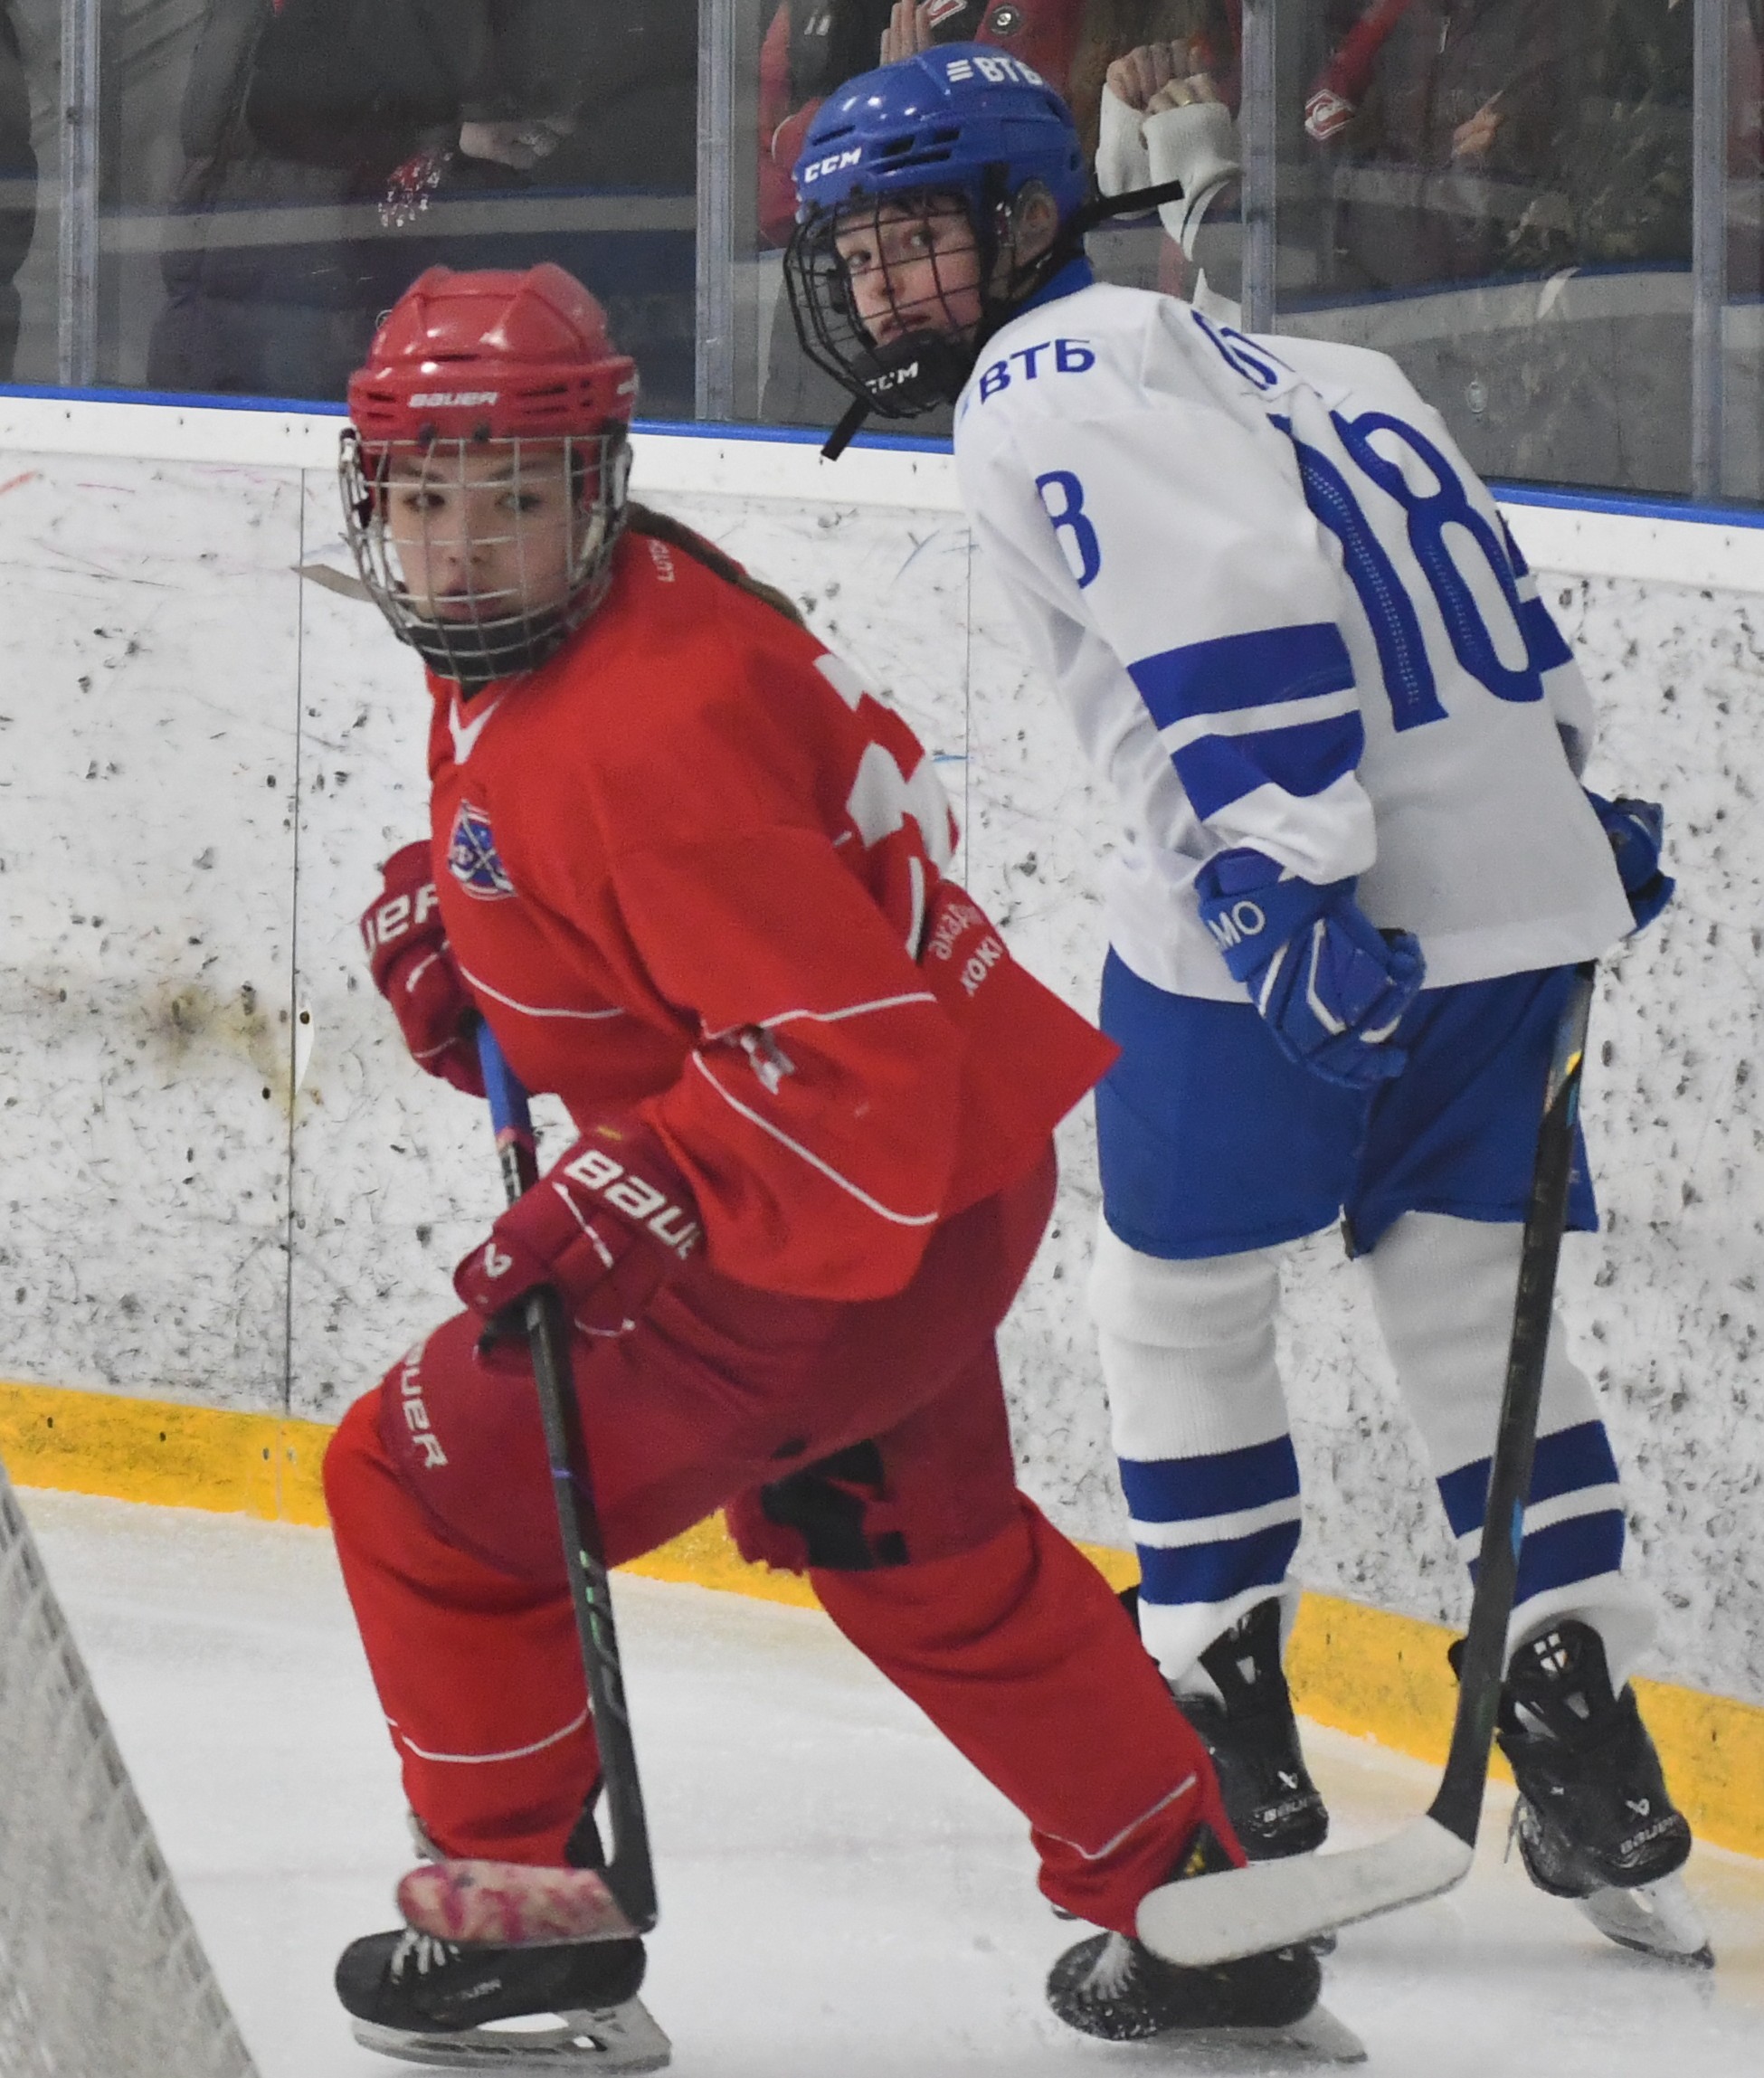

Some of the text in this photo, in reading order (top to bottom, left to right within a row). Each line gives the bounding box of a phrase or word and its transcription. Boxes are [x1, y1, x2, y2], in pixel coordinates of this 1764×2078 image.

[972, 57, 1043, 86] ВТБ
[804, 147, 862, 184] CCM
[979, 338, 1096, 405] ВТБ
[1266, 411, 1544, 733] 18
